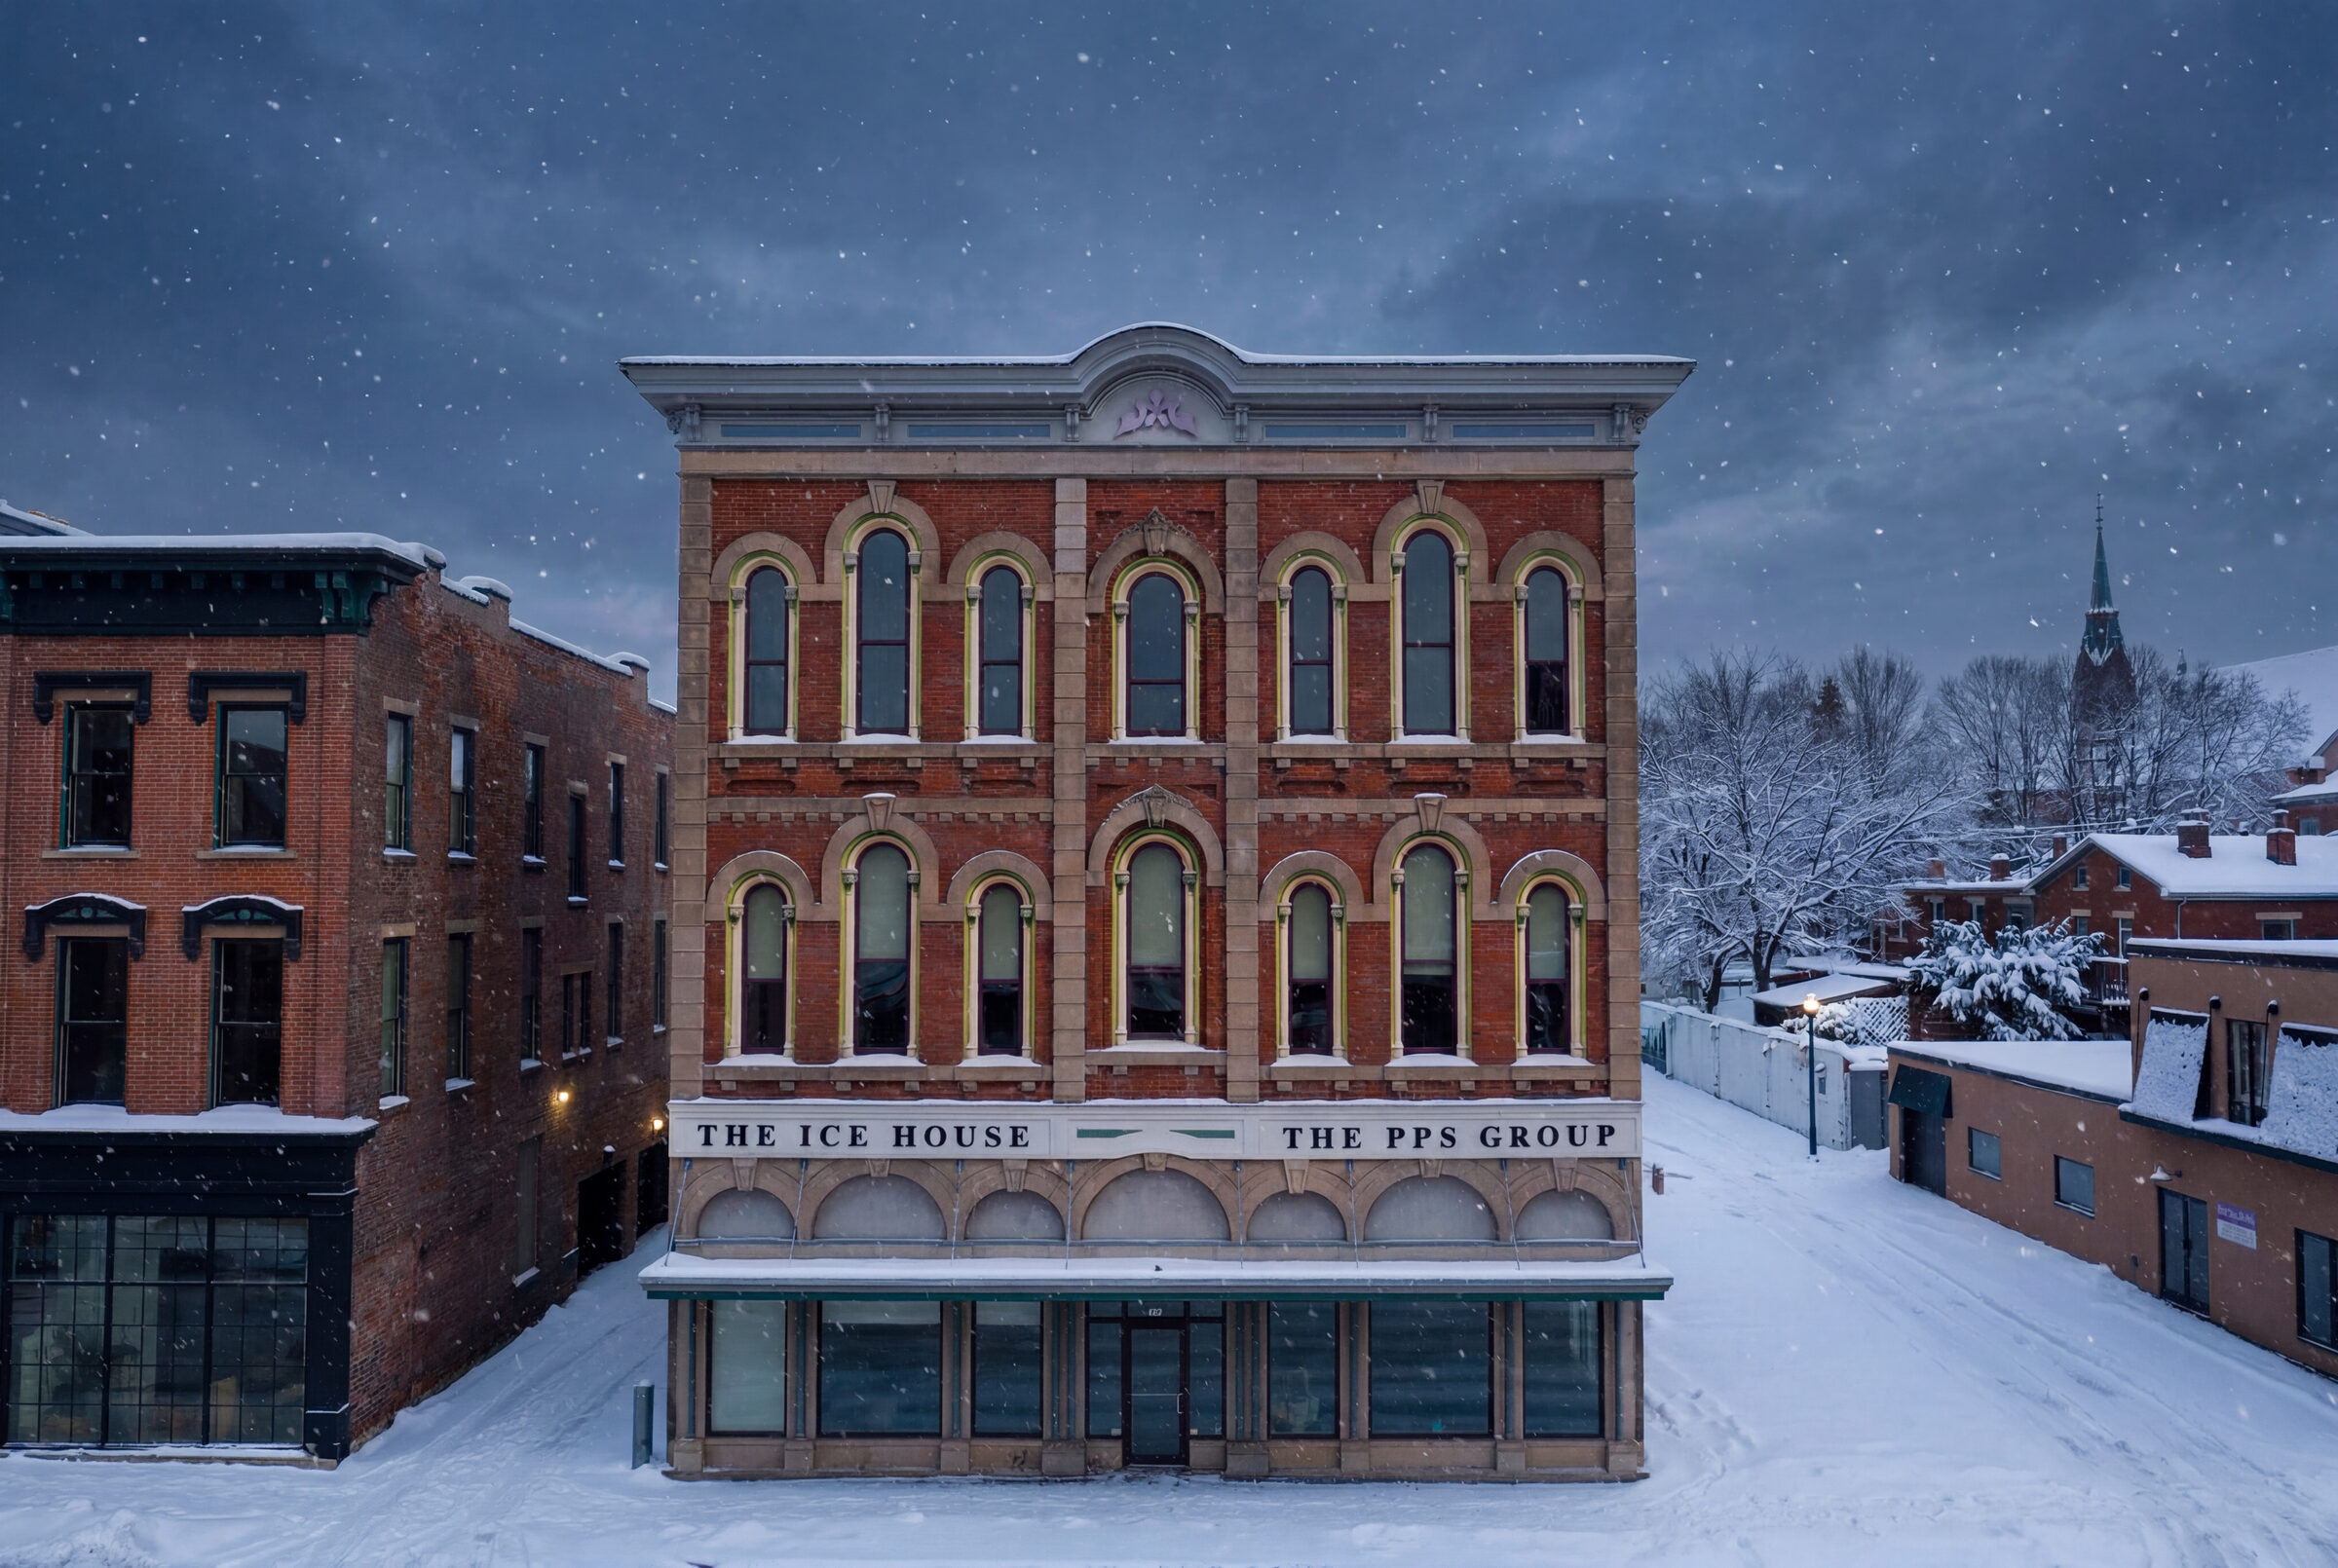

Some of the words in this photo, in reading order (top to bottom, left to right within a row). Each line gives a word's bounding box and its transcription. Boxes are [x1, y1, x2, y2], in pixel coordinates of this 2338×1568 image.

[698, 1125, 775, 1147] THE
[799, 1125, 868, 1147] ICE
[892, 1125, 1030, 1148] HOUSE
[1282, 1127, 1362, 1149] THE
[1386, 1126, 1456, 1149] PPS
[1479, 1124, 1615, 1148] GROUP
